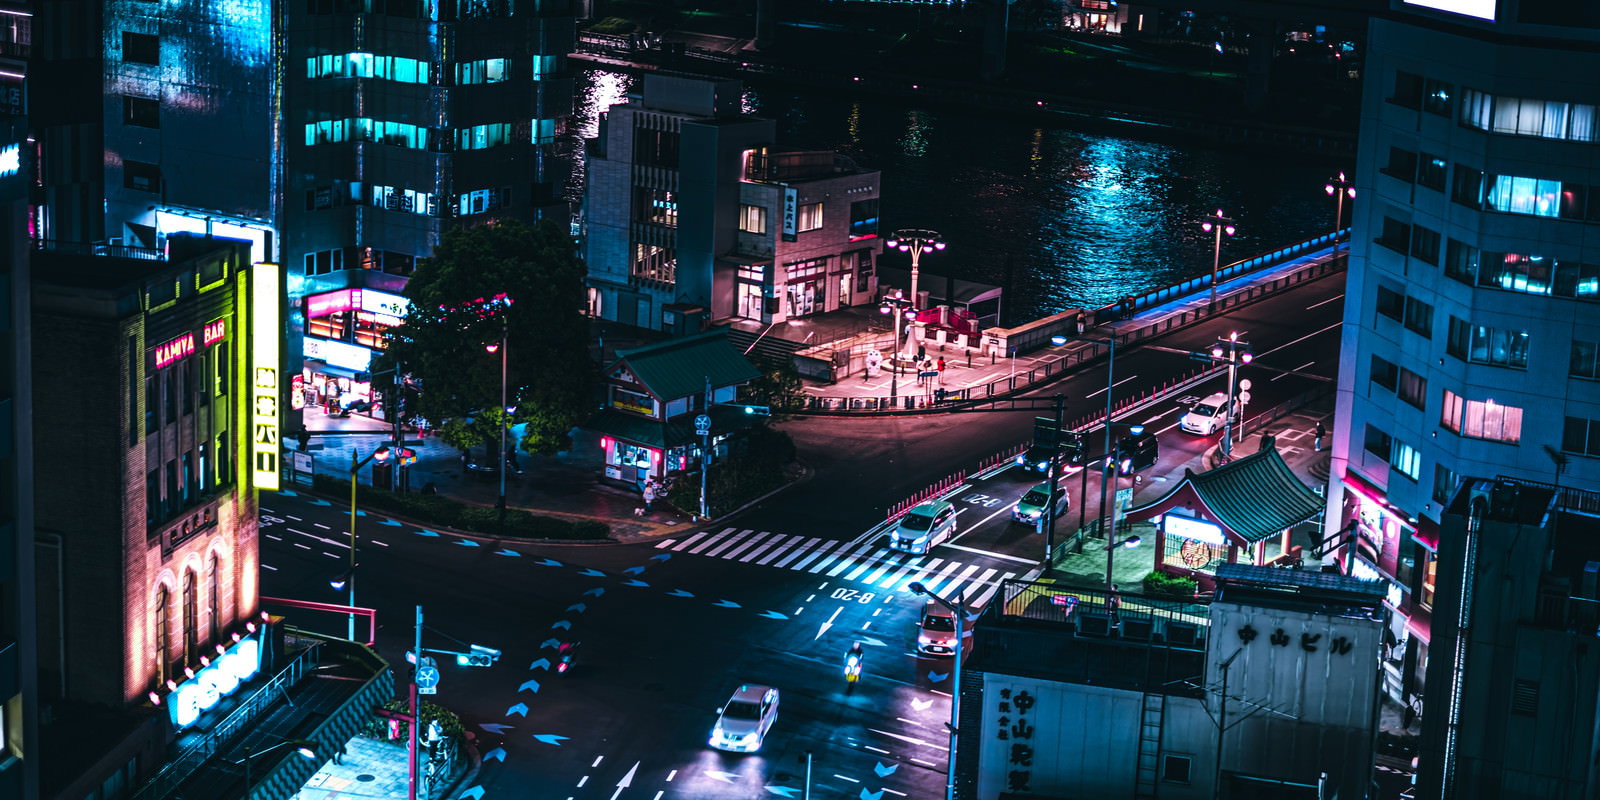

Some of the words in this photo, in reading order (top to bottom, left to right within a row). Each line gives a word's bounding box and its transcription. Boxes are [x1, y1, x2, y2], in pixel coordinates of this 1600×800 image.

[785, 194, 794, 230] 水上バス
[155, 332, 195, 370] KAMIYA
[204, 319, 225, 347] BAR
[961, 493, 1002, 508] 8-20
[830, 587, 876, 604] 8-20
[1237, 624, 1353, 656] 中山ビル
[997, 688, 1012, 740] 有限会社
